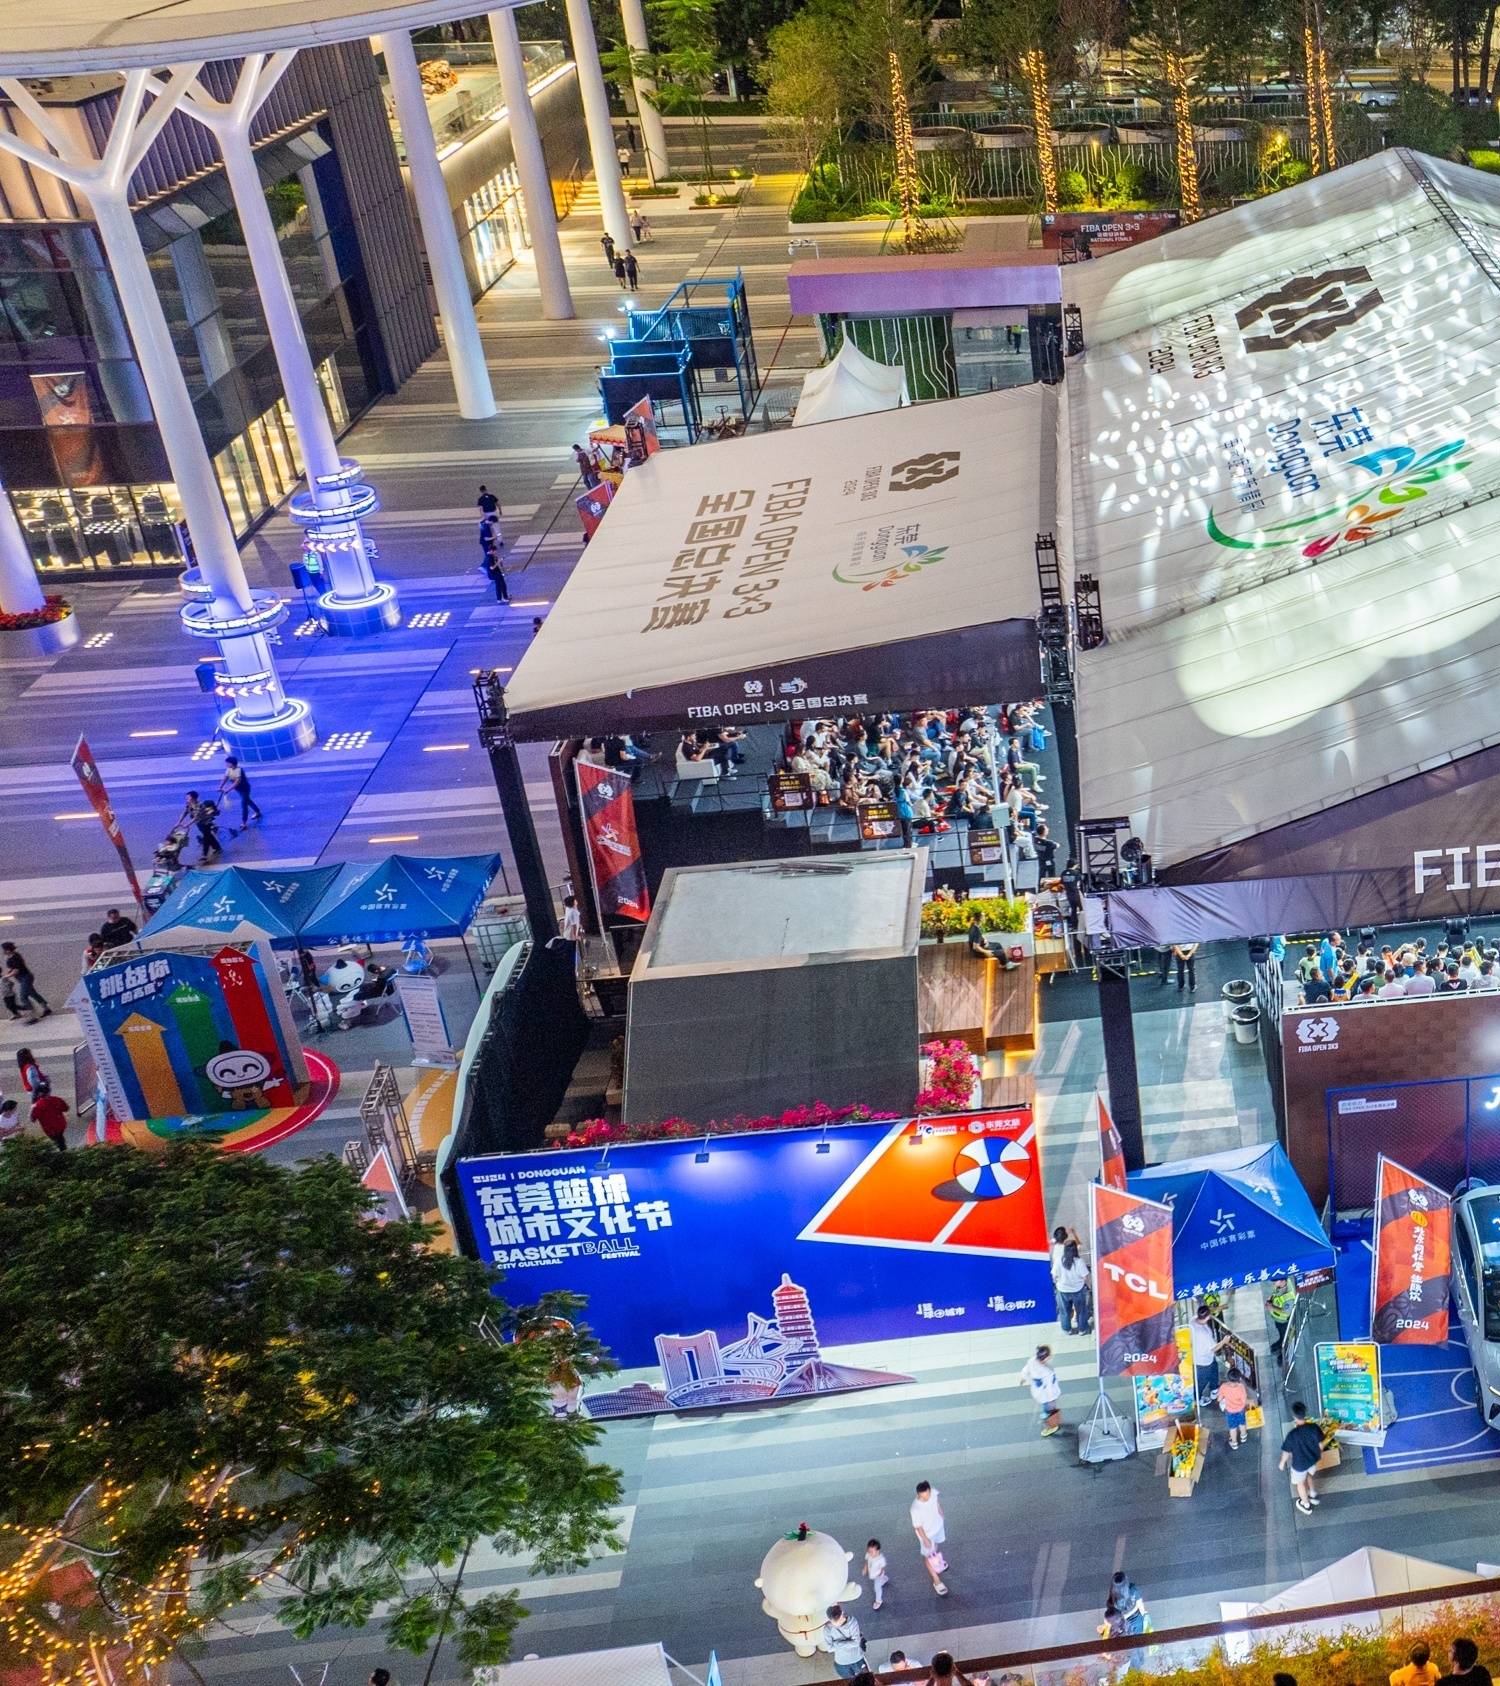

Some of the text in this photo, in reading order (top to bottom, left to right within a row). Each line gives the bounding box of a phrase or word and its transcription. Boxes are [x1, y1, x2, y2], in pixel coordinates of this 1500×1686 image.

[1148, 345, 1176, 375] 2024
[1187, 336, 1221, 359] OPEN
[1309, 407, 1374, 458] 东莞
[1266, 418, 1320, 498] Dongguan
[760, 478, 812, 526] FIBA
[640, 490, 756, 633] 全国总决赛
[739, 526, 798, 578] OPEN
[688, 706, 720, 718] FIBA
[724, 703, 761, 716] OPEN
[792, 693, 869, 710] 全国总决赛
[100, 959, 170, 999] 挑战你
[1298, 1045, 1312, 1053] FIBA
[1313, 1044, 1327, 1052] OPEN
[518, 1166, 586, 1180] DONGGUAN
[476, 1173, 630, 1216] 东莞篮球
[485, 1200, 673, 1246] 城市文化节
[493, 1237, 639, 1263] BASKETBALL
[1200, 1230, 1256, 1250] 中国体育彩票
[518, 1258, 563, 1268] CULTURAL
[601, 1251, 641, 1260] FESTIVAL
[1103, 1262, 1168, 1300] TCL
[1177, 1277, 1234, 1299] 公益体彩
[1244, 1263, 1299, 1284] 乐善人生
[1396, 1319, 1429, 1330] 2024
[1123, 1353, 1158, 1363] 2024
